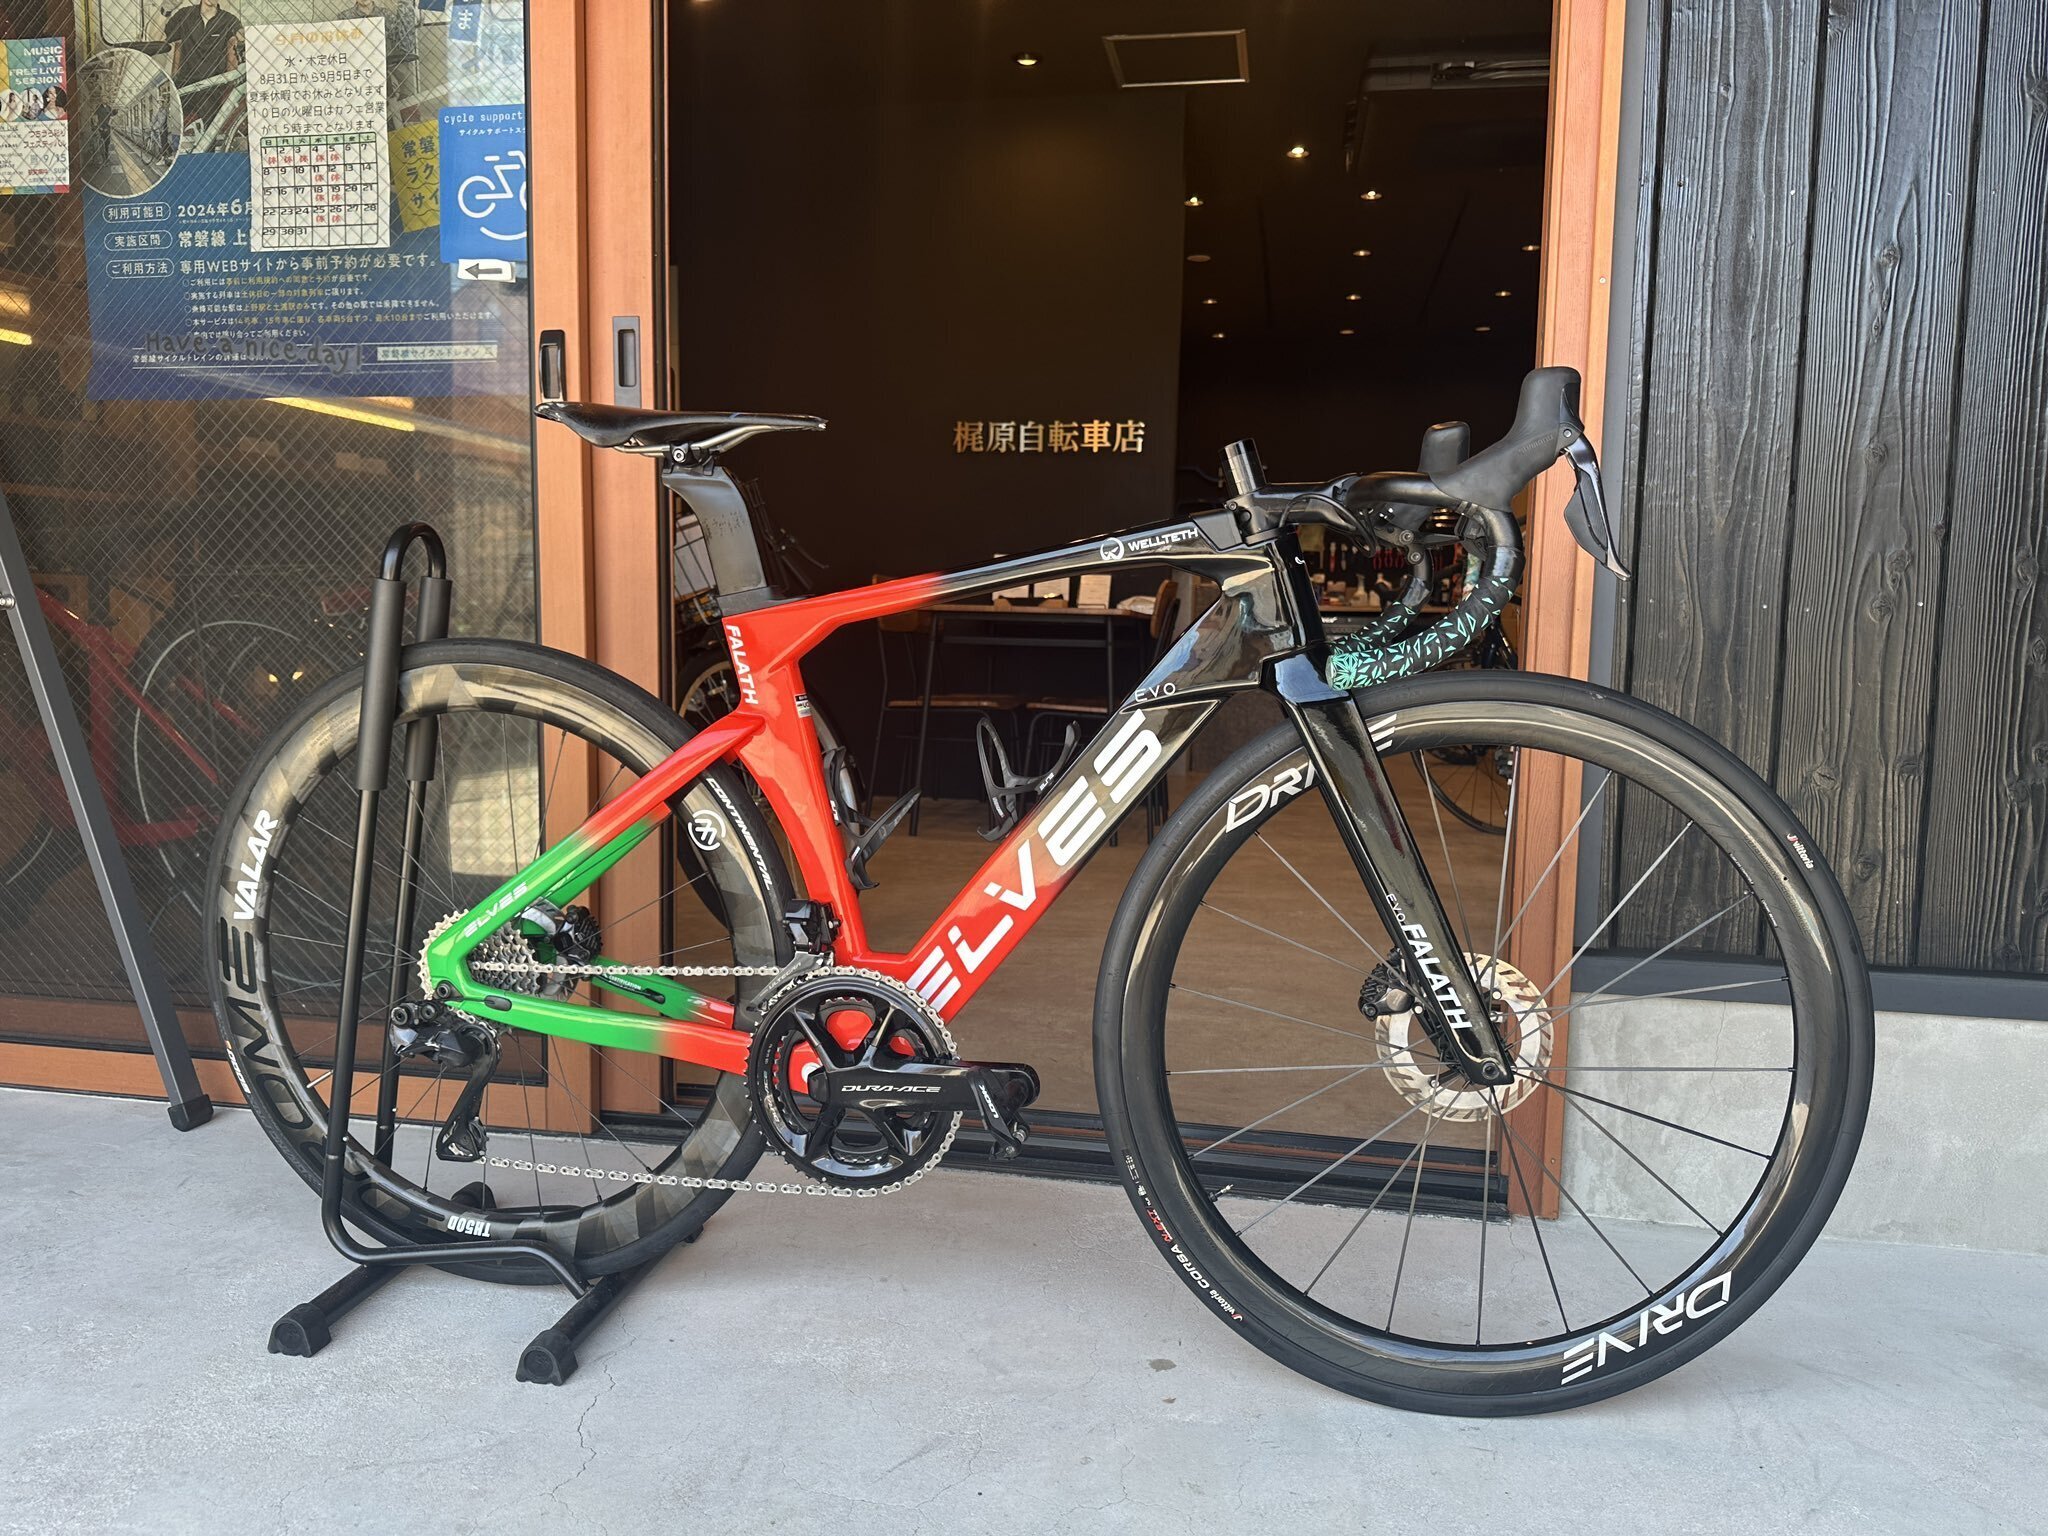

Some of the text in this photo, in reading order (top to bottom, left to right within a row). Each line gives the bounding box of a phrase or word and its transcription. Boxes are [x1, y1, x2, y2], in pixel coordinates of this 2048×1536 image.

[458, 9, 473, 30] ま
[23, 46, 63, 56] MUSIC
[37, 55, 63, 64] ART
[285, 53, 347, 67] 水・木定休日
[9, 68, 38, 76] FREE
[15, 76, 63, 85] SESSION
[260, 69, 372, 85] 8月31日から9月5日まで
[250, 85, 383, 102] 夏季休暇でお休みとなります
[444, 111, 523, 125] cycle support
[107, 206, 164, 220] 利用可能日
[114, 235, 161, 248] 実施区間
[178, 230, 226, 248] 常磐線
[111, 252, 435, 275] ご利用方法 専用WEBサイトから事前予約が必要です。
[146, 331, 363, 376] Have a nice day!
[953, 419, 1145, 453] 梶原自転車店
[1128, 528, 1199, 552] WELLTETH
[725, 624, 759, 705] FALATH
[1135, 682, 1176, 702] EVO
[1226, 714, 1398, 834] DRIE
[706, 778, 773, 891] CONTINENTAL
[233, 809, 279, 920] VALAR
[906, 708, 1162, 1013] ELVES
[1792, 839, 1814, 869] vittoria
[464, 881, 528, 938] ELVES
[1386, 893, 1473, 1030] EVO FALATH
[227, 1048, 252, 1094] 5000
[841, 1084, 942, 1094] DURA-ACE
[1171, 1244, 1210, 1290] CORSA
[1210, 1289, 1237, 1315] vittoria
[1561, 1270, 1732, 1386] DRIVE
